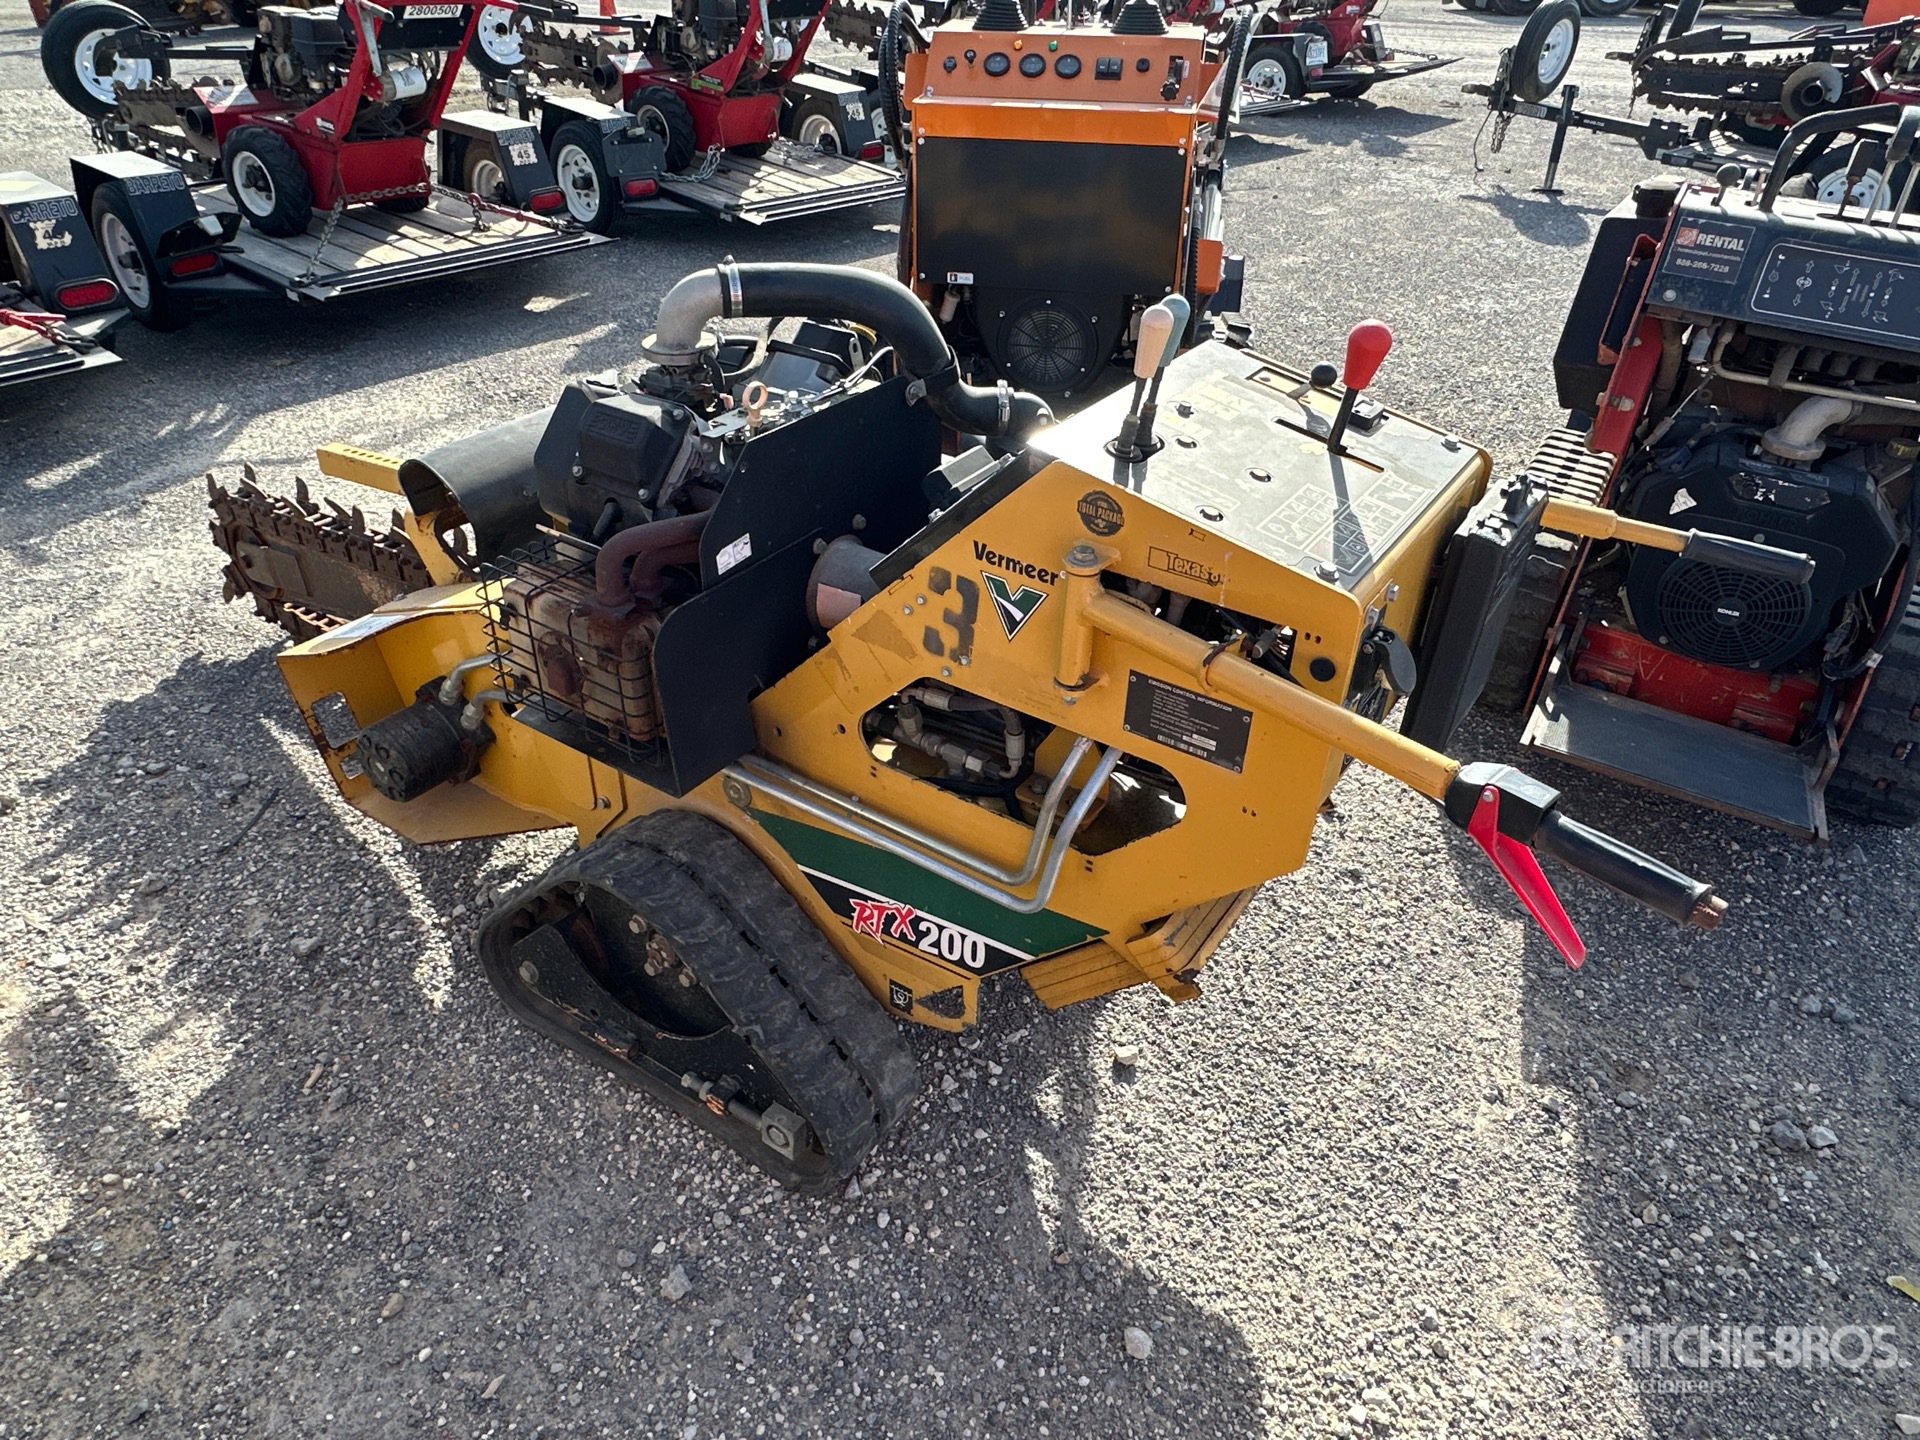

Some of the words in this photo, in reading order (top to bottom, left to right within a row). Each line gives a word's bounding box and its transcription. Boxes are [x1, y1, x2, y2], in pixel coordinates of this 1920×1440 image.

[408, 5, 459, 17] 2800500
[516, 150, 531, 160] 45
[125, 172, 186, 196] BARRETO
[1696, 233, 1745, 251] RENTAL
[1077, 500, 1099, 518] TOTAL
[1098, 506, 1125, 527] PACKAGE
[973, 540, 1059, 586] Vermeer
[1167, 553, 1213, 581] Texas
[1172, 684, 1196, 700] CONTROL
[849, 898, 917, 945] RTX
[918, 920, 986, 968] 200
